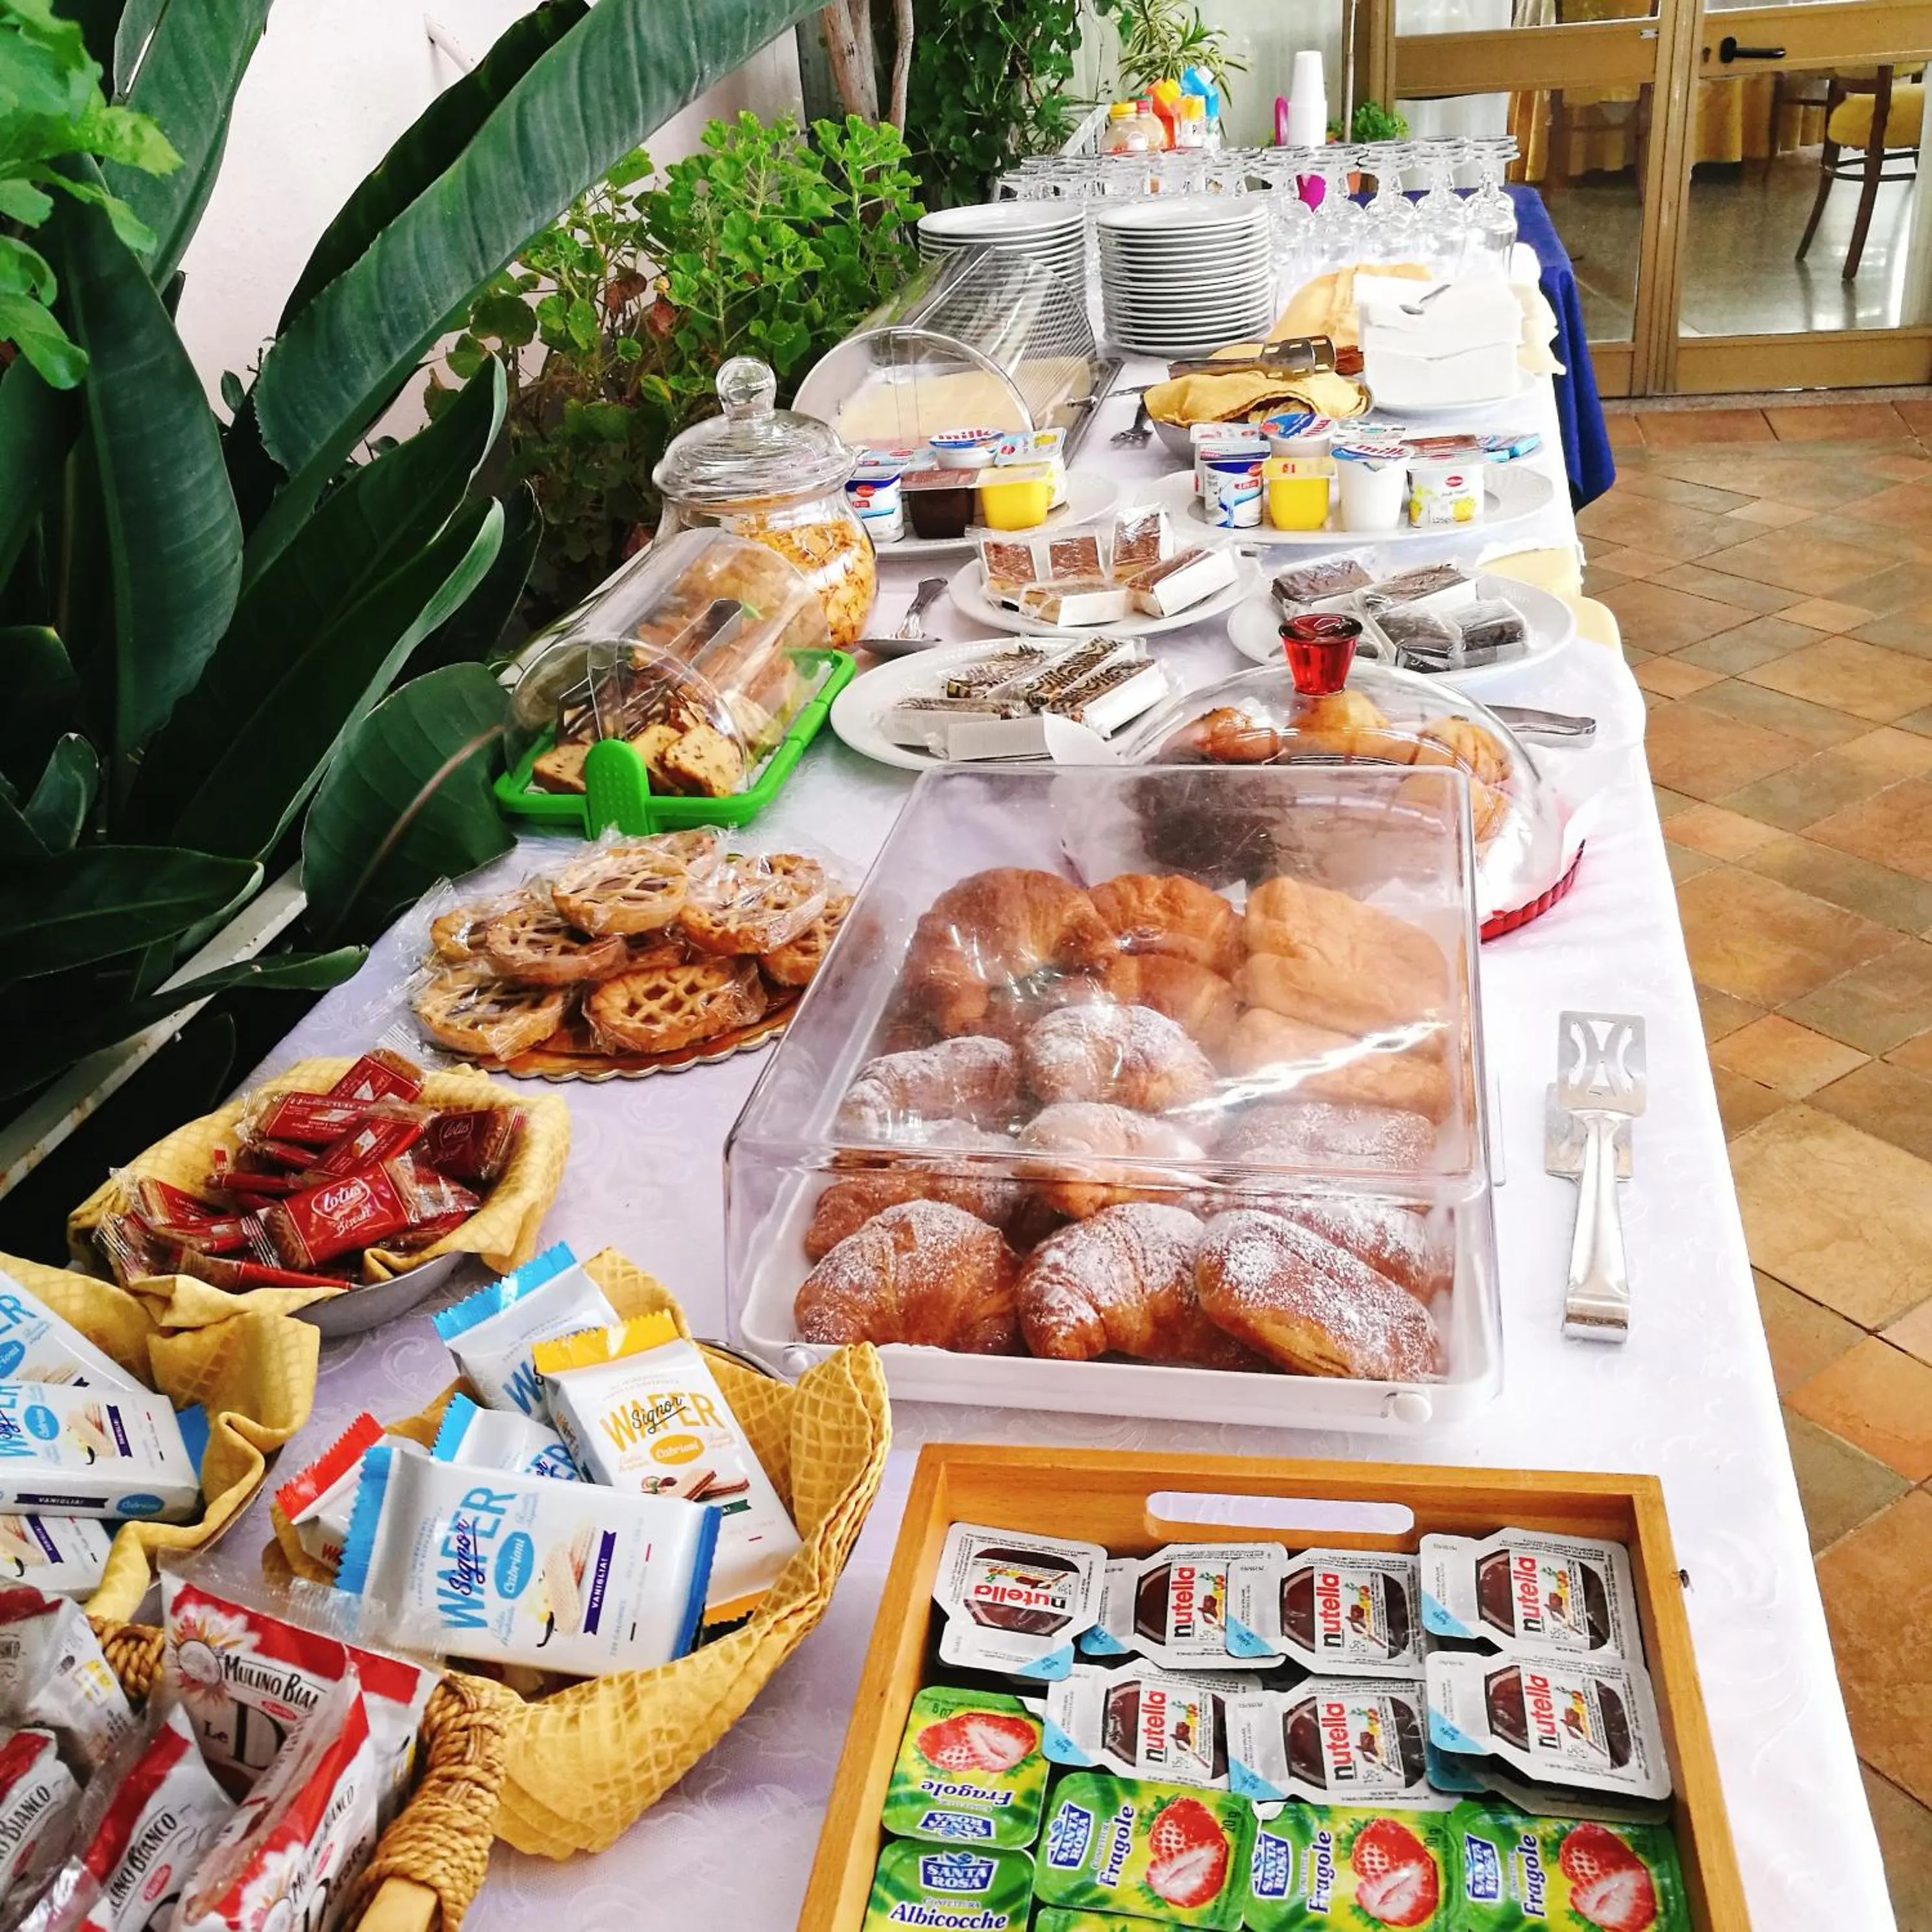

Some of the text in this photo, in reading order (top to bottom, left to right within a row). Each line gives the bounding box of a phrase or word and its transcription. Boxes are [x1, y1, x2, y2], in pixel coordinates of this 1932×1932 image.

[323, 1184, 362, 1213] Lotus
[599, 1391, 725, 1452] WAFER
[632, 1397, 686, 1434] Signor
[437, 1487, 518, 1628] WAFER
[449, 1518, 486, 1596] Signor
[591, 1557, 609, 1609] VANIGLIA!
[974, 1585, 1066, 1609] nutella
[1171, 1567, 1196, 1638] nutella
[1316, 1572, 1342, 1648] nutella
[1513, 1557, 1541, 1633] nutella
[224, 1654, 282, 1696] MULINO
[203, 1720, 228, 1743] Le
[1141, 1690, 1167, 1763] nutella
[1525, 1674, 1557, 1749] nutella
[1321, 1703, 1354, 1780] nutella
[922, 1781, 1012, 1805] Fragole
[1058, 1812, 1080, 1861] SANTA
[1069, 1818, 1089, 1860] ROSA
[1098, 1805, 1134, 1887] Fragole
[927, 1864, 987, 1878] SANTA
[932, 1876, 982, 1889] ROSA
[1309, 1831, 1335, 1913] Fragole
[1517, 1835, 1546, 1917] Fragole
[890, 1903, 1008, 1930] Albicocche
